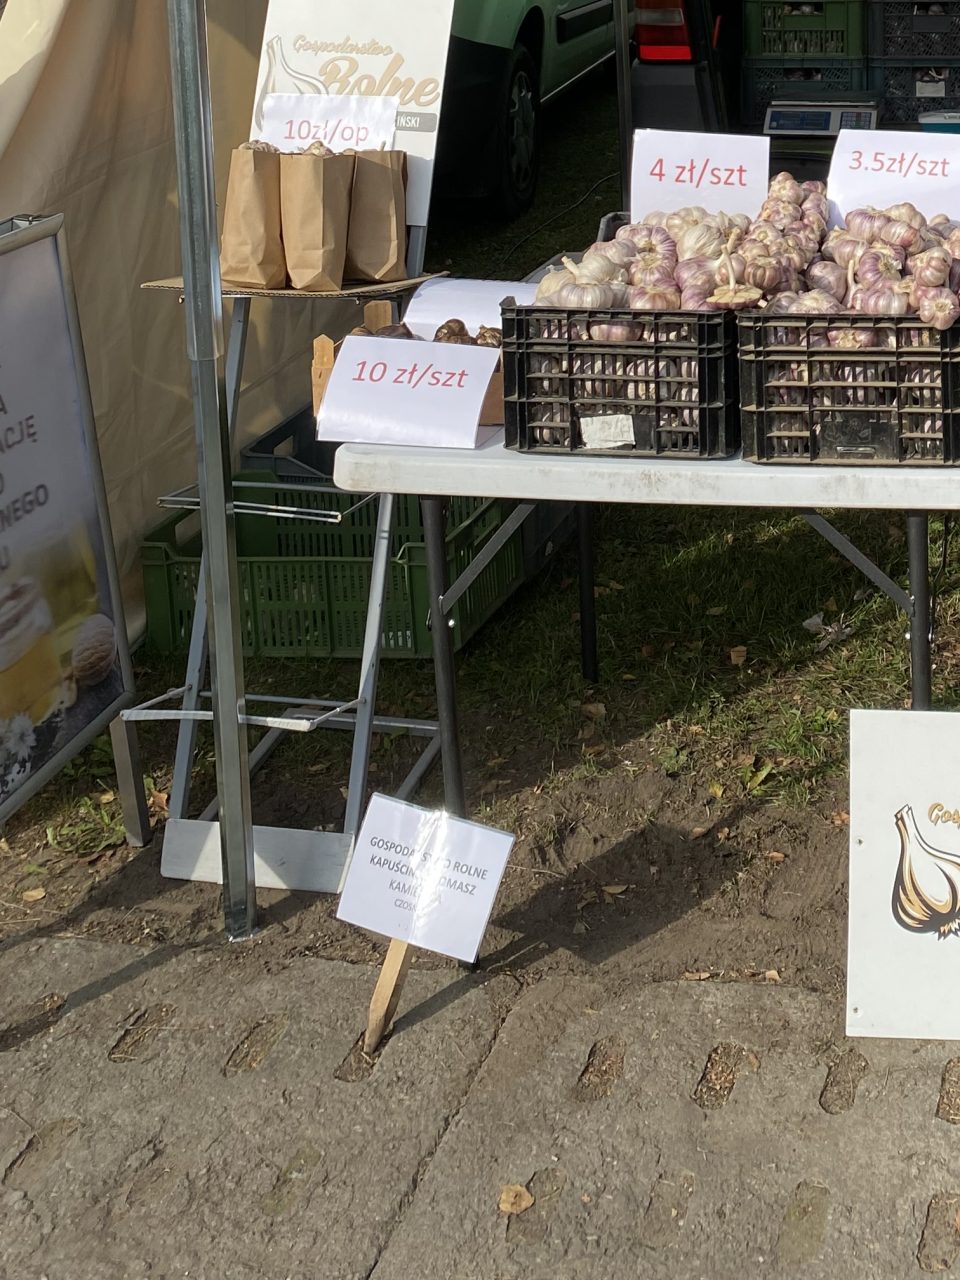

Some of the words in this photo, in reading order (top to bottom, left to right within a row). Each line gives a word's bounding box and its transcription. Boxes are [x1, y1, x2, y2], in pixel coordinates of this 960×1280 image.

[649, 158, 666, 182] 4
[674, 158, 748, 188] zł/szt
[848, 150, 950, 177] 3.5zł/szt
[352, 360, 388, 382] 10
[392, 363, 469, 389] zł/szt
[453, 861, 488, 880] ROLNE
[436, 875, 477, 896] OMASZ
